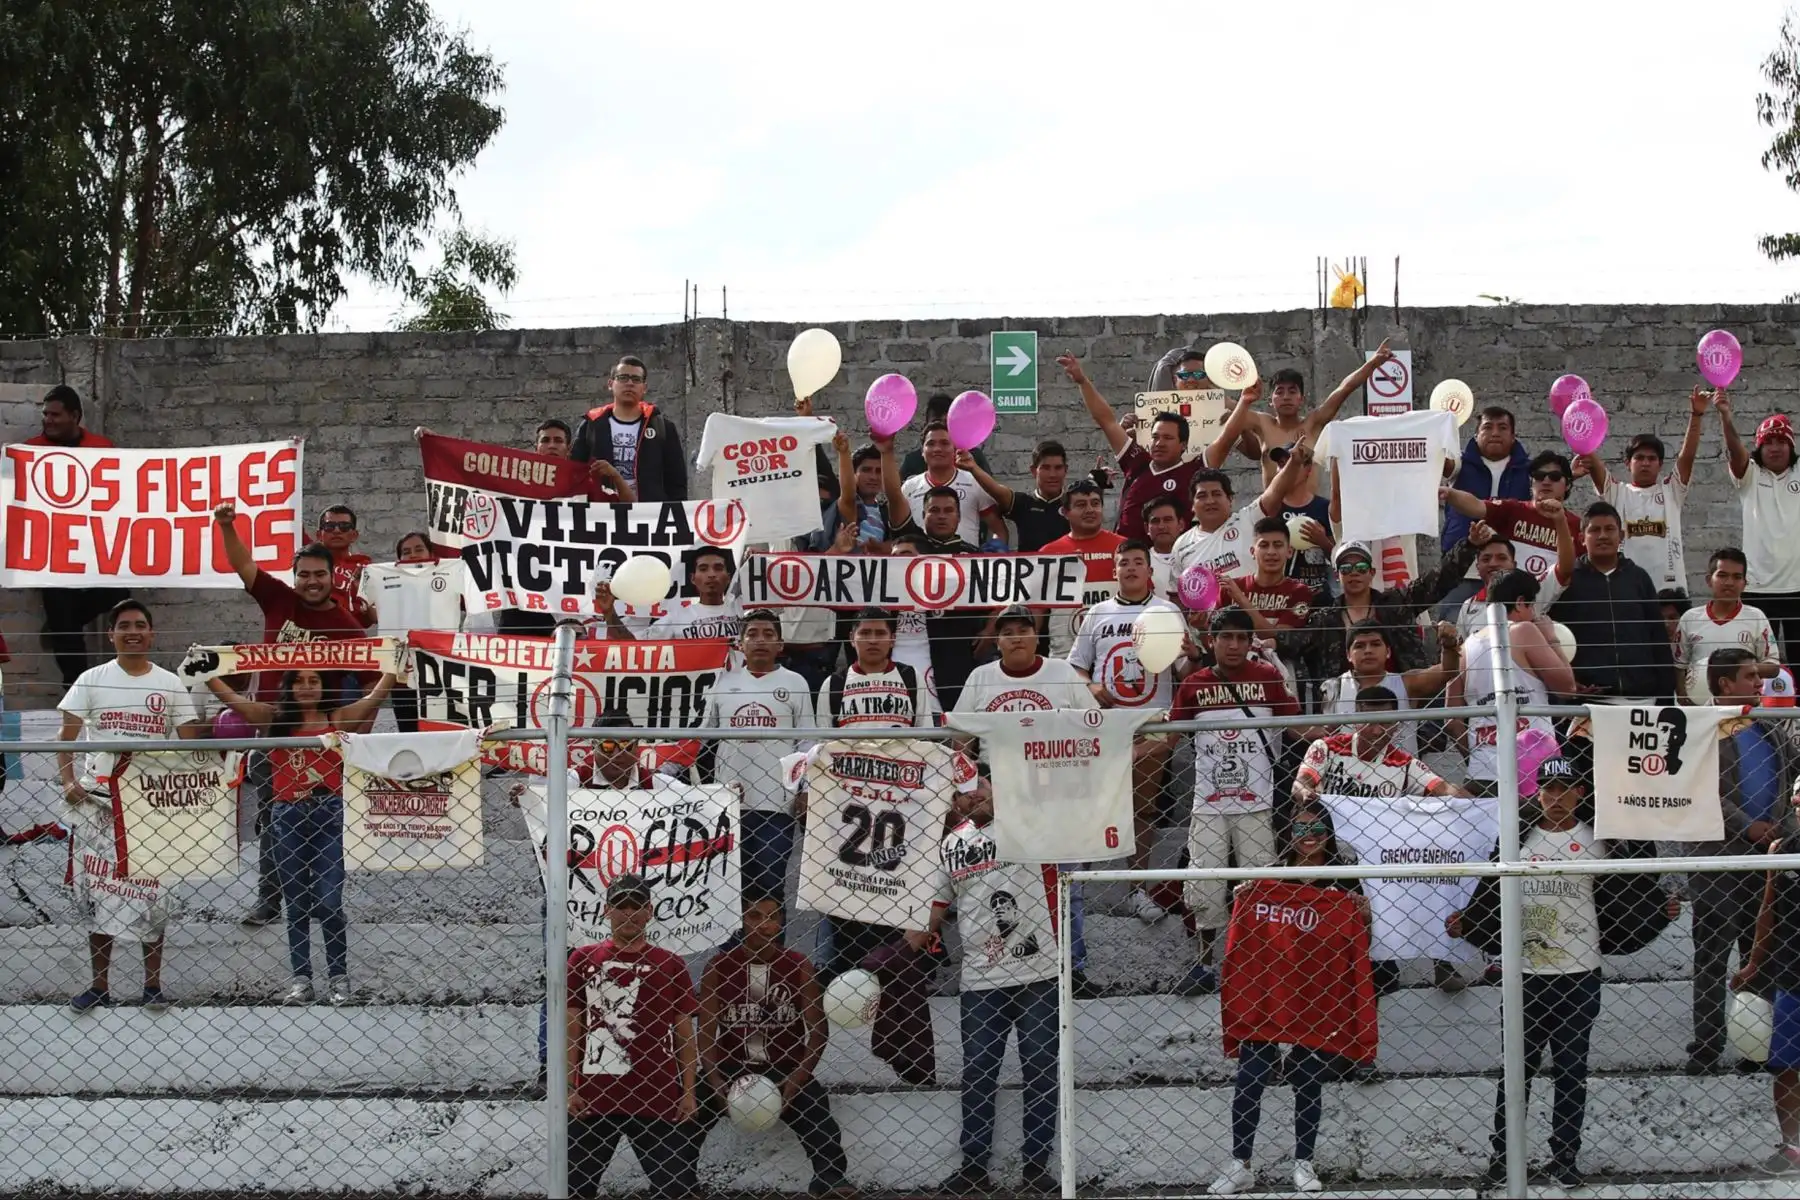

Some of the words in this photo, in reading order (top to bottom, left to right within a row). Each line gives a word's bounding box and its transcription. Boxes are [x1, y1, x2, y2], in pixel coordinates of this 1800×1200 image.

[997, 395, 1032, 407] SALIDA
[1372, 404, 1408, 413] PROHIBIDO
[723, 435, 798, 460] CONO
[1352, 443, 1361, 461] LA
[1389, 442, 1398, 459] DE
[1407, 442, 1427, 459] GENTE
[463, 451, 557, 487] COLLIQUE
[736, 453, 788, 475] SUR
[5, 446, 120, 512] TUS
[137, 447, 298, 513] FIELES
[727, 469, 802, 488] TRUJILLO
[495, 497, 695, 546] VILLA
[5, 504, 296, 576] DEVOTOS
[968, 556, 1079, 604] NORTE
[603, 645, 677, 671] ALTA
[845, 681, 870, 690] CONO
[840, 698, 859, 715] LA
[730, 715, 777, 728] SUELTOS
[1630, 708, 1655, 727] OL
[1629, 731, 1658, 751] MO
[1222, 755, 1238, 773] 5
[1544, 760, 1573, 777] KING
[158, 770, 220, 791] VICTORIA
[569, 808, 629, 822] CONO
[641, 799, 705, 820] NORTE
[1624, 794, 1647, 808] AÑOS
[1649, 796, 1660, 808] DE
[1662, 797, 1692, 808] PASION
[840, 803, 906, 872] 20
[1105, 826, 1119, 849] 6
[1380, 848, 1421, 864] GREMCO
[1422, 848, 1465, 864] ENEMIGO
